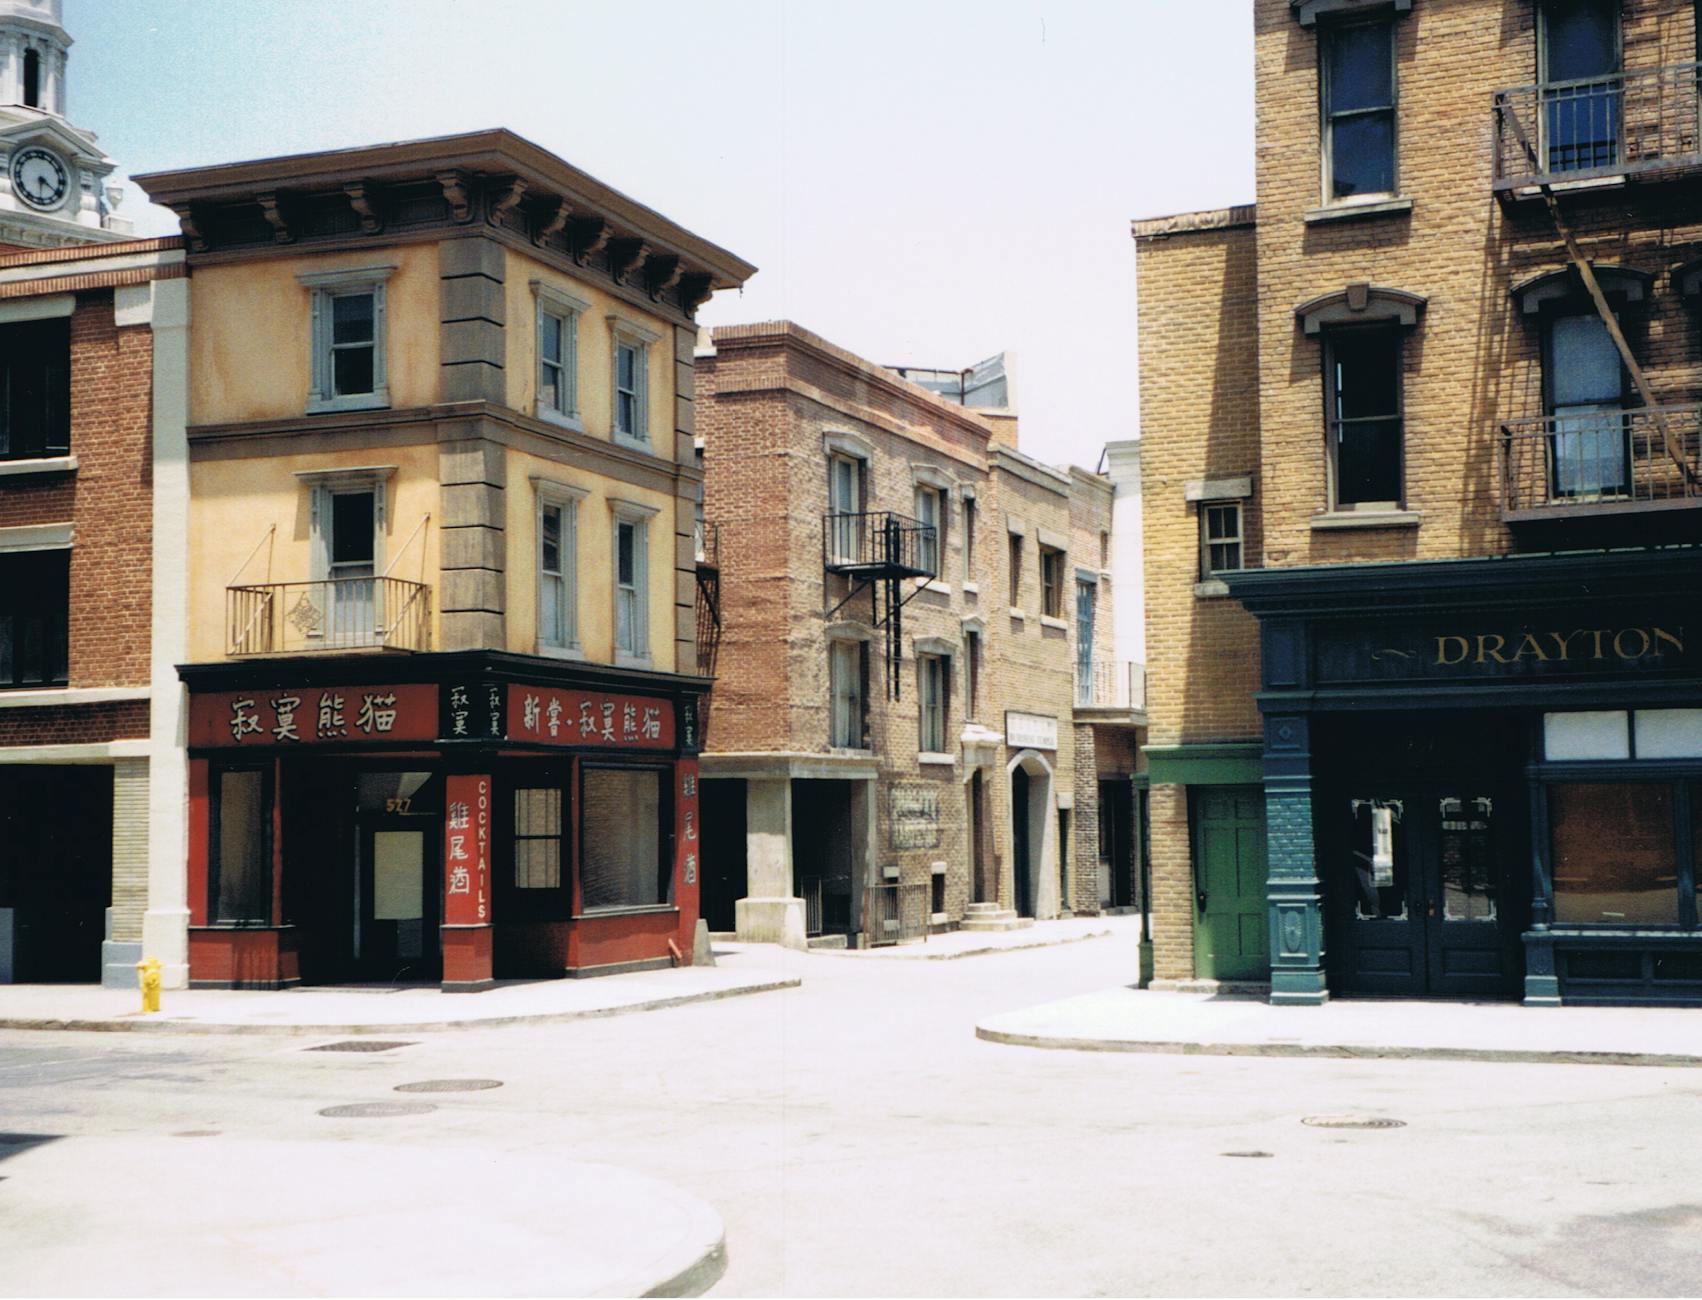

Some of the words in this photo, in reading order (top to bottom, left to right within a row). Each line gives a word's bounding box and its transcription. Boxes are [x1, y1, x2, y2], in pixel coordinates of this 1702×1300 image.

[1433, 626, 1685, 665] DRAYTON
[229, 692, 398, 742] 寂寞熊猫
[450, 685, 470, 736] 寂寞
[477, 781, 487, 919] COCKTAILS
